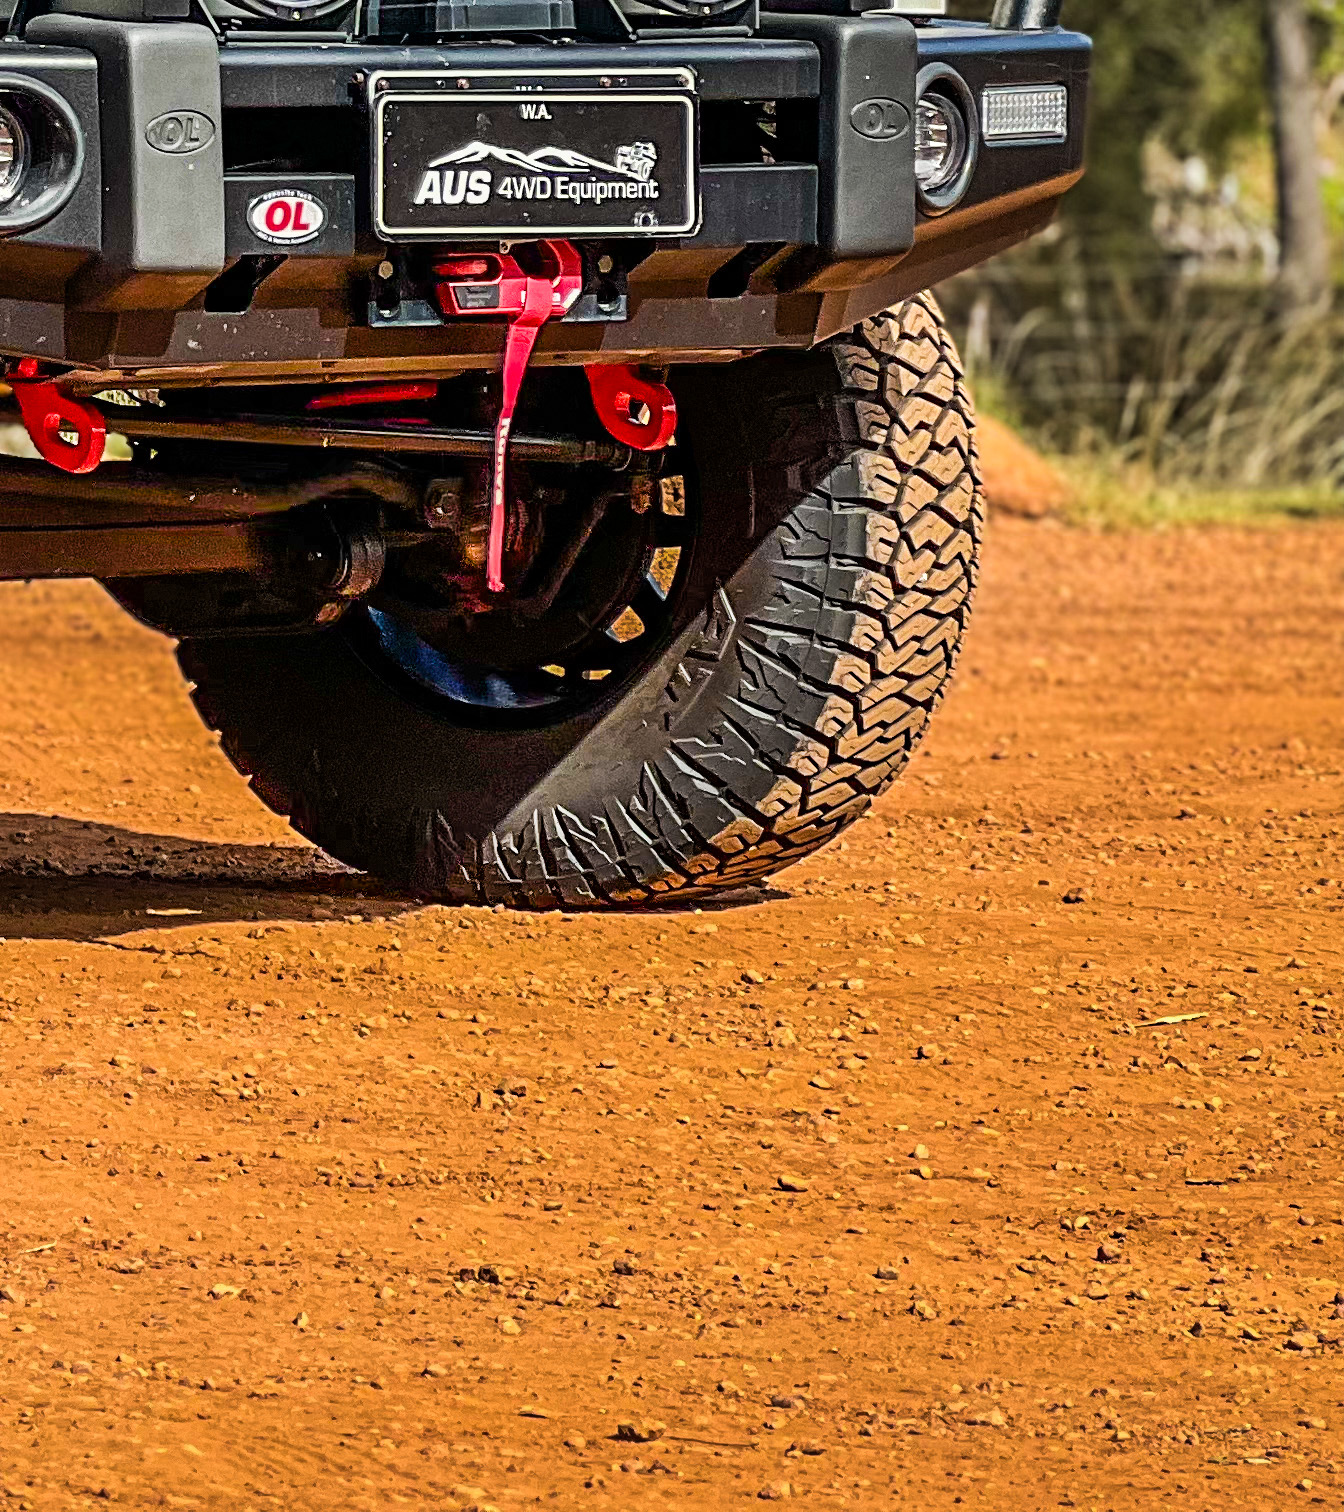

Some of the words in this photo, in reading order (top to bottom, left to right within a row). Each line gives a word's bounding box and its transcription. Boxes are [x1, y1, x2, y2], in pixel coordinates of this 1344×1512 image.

[414, 170, 492, 205] AUS
[497, 176, 552, 199] 4WD
[555, 176, 660, 205] Equipment
[265, 200, 310, 232] OL
